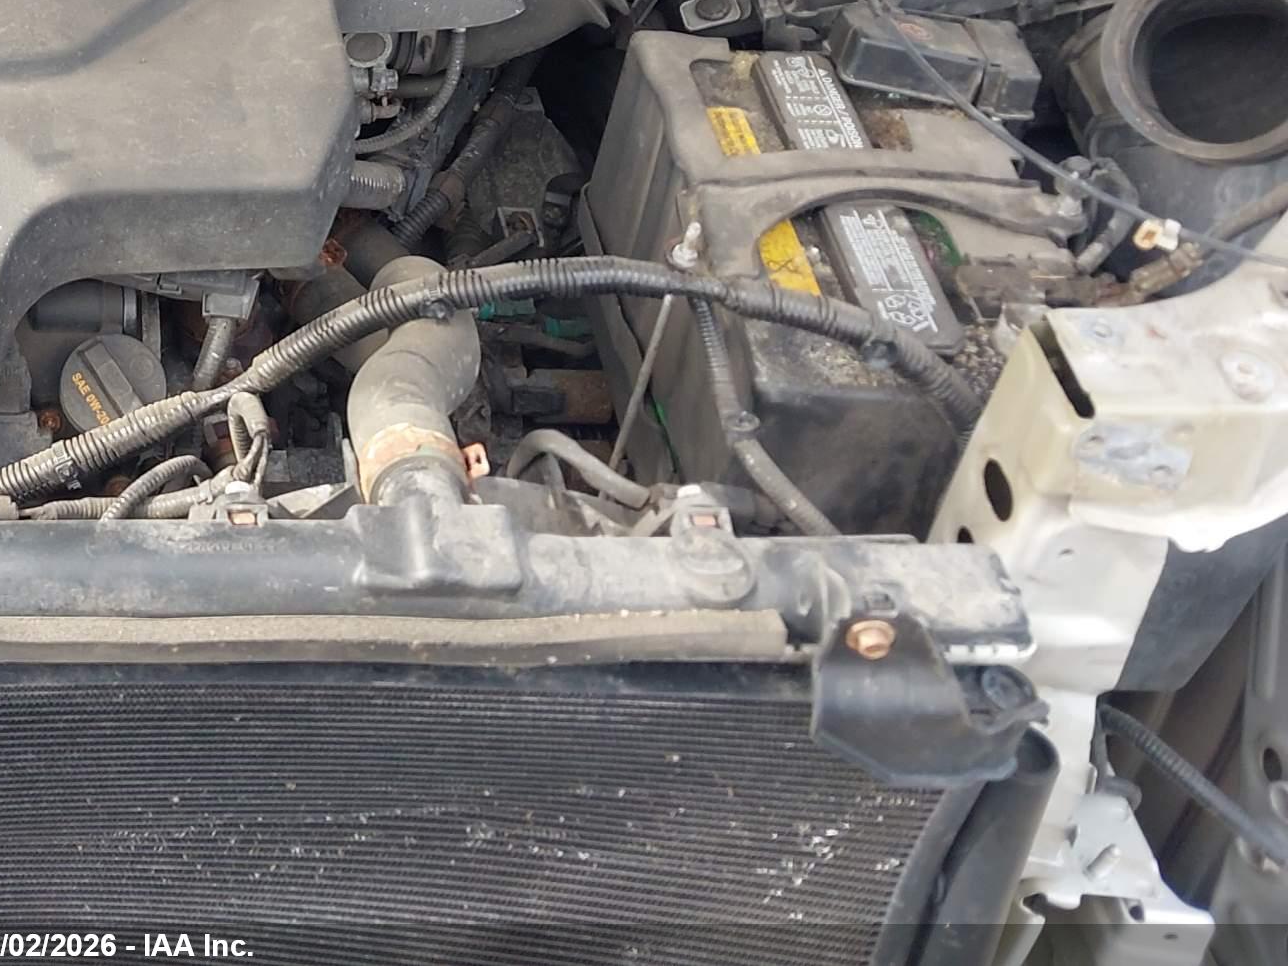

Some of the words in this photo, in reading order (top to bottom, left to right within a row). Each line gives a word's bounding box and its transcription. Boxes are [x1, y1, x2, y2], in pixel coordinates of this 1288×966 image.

[822, 77, 846, 110] DANGER
[840, 116, 864, 148] POISON
[72, 372, 91, 395] SAE
[85, 393, 111, 426] 0W-20
